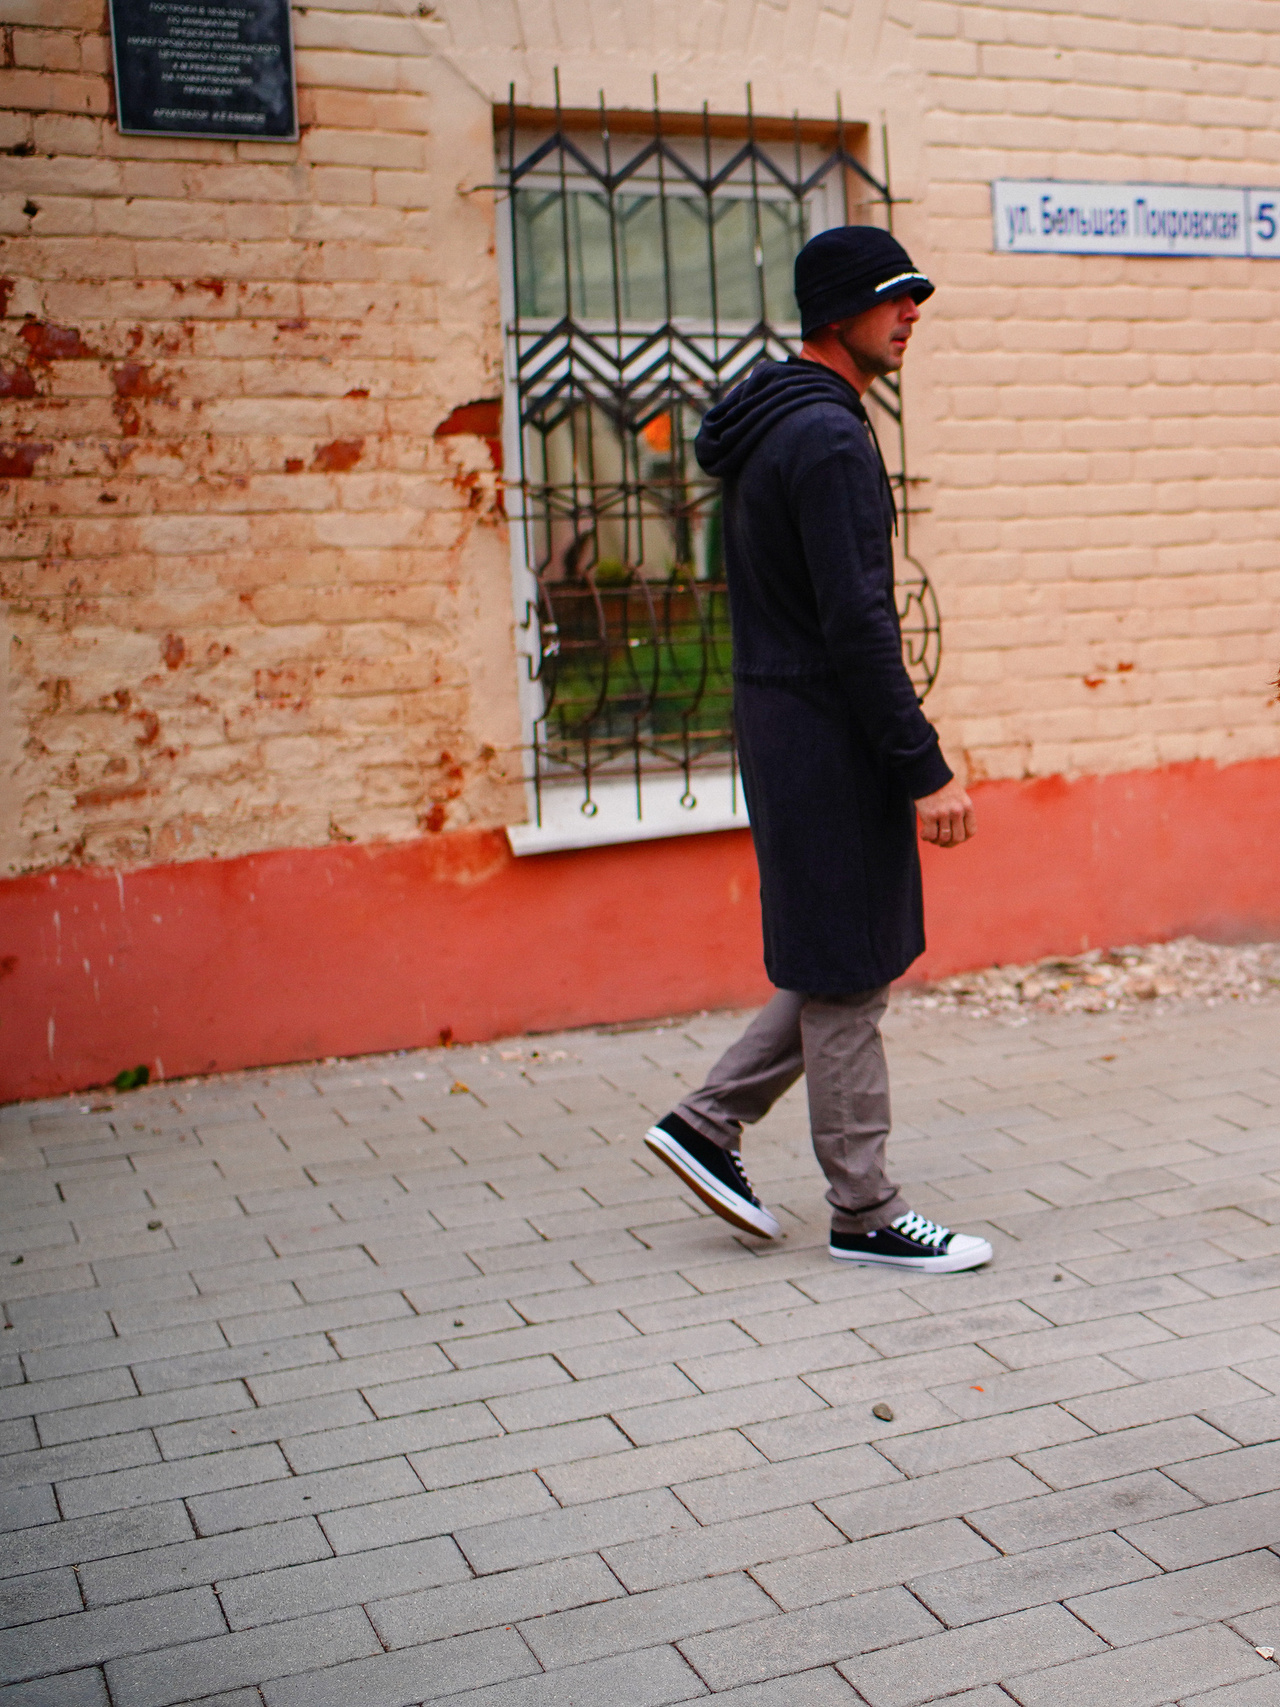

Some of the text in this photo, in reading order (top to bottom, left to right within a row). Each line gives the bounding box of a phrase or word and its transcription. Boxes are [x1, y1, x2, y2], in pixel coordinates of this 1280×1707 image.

[1006, 195, 1239, 248] ул. Большая Покровская
